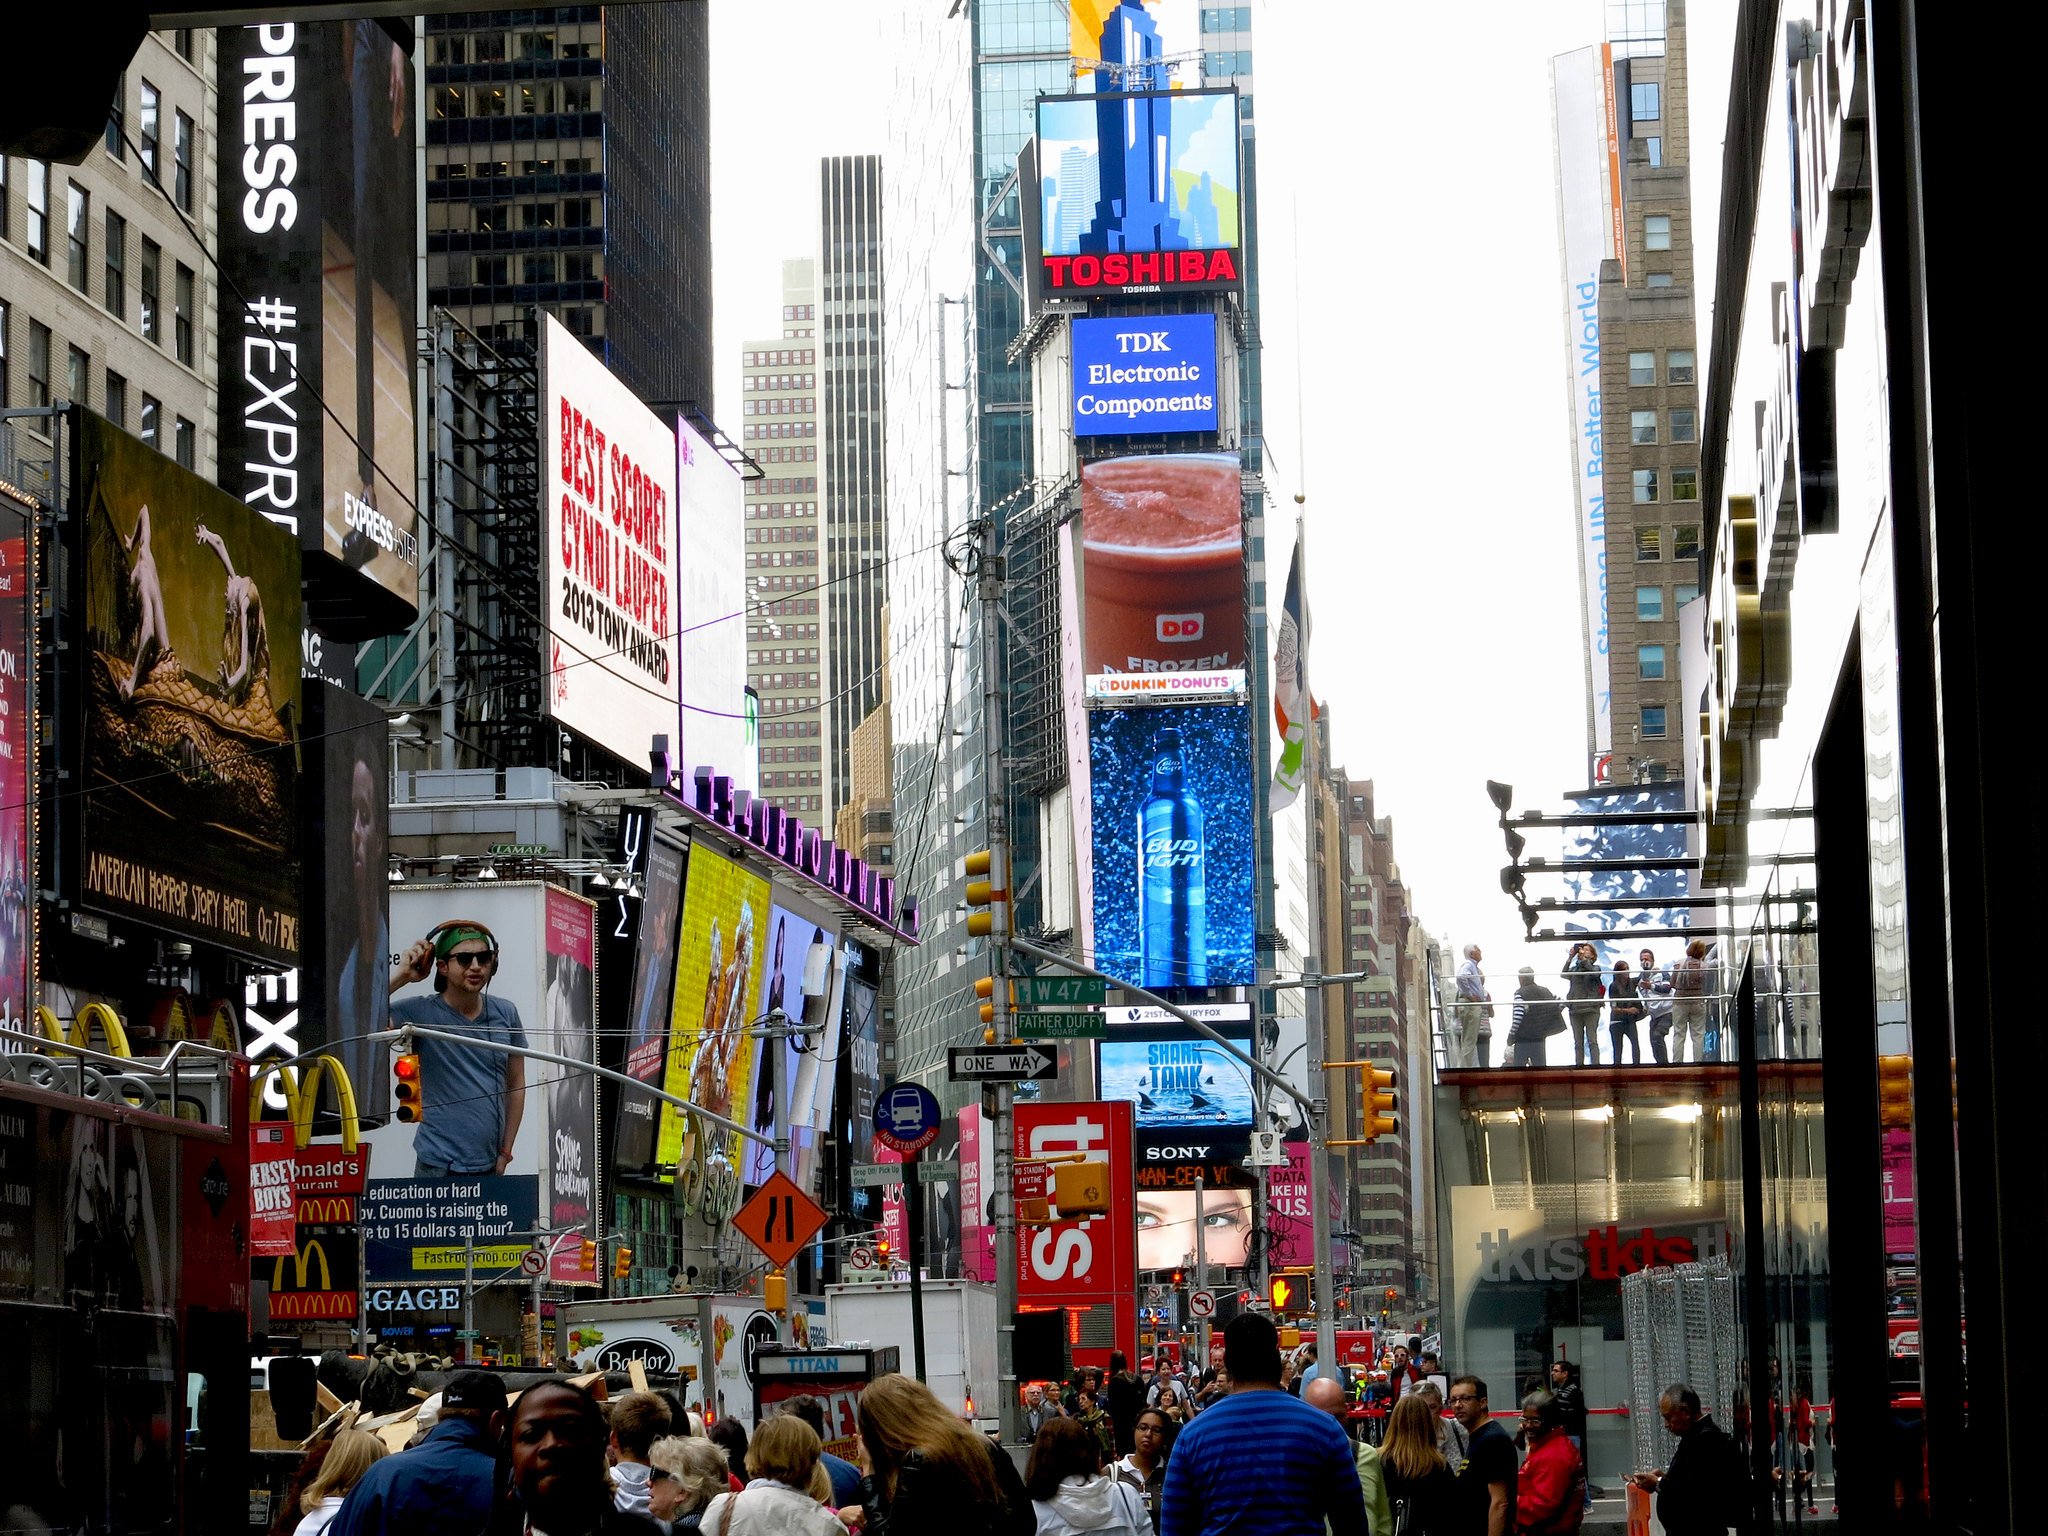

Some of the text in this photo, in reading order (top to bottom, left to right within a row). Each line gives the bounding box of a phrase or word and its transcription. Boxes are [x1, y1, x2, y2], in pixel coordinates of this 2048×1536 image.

[1044, 250, 1237, 287] TOSHIBA
[1122, 285, 1161, 294] TOSHIBA
[1044, 304, 1086, 312] SHERWOOD
[1577, 272, 1599, 376] World.
[1116, 332, 1171, 353] TDK
[1088, 361, 1200, 385] Electronic
[1077, 393, 1213, 418] Components
[561, 395, 667, 567] BEST SCORE!
[345, 491, 393, 552] EXPRESS
[561, 493, 669, 643] CYNDI LAUPER
[562, 576, 595, 634] 2013
[596, 600, 629, 658] TONY
[629, 624, 669, 686] AWARD
[1162, 619, 1200, 636] DD
[1127, 652, 1229, 673] FROZEN
[1171, 677, 1228, 689] DONUTS
[495, 845, 543, 855] LAMAR
[1146, 839, 1198, 854] BUD
[772, 808, 894, 921] BROADWAY
[88, 851, 145, 905] AMERICAN
[149, 870, 188, 920] HORROR
[191, 885, 220, 928] STORY
[223, 895, 250, 938] HOTEL
[280, 914, 296, 951] FX
[1036, 980, 1103, 1001] W 47 ST
[1018, 1013, 1105, 1029] FATHER DUFFY
[1204, 1008, 1222, 1016] FOX
[1047, 1027, 1078, 1036] SQUARE
[964, 1055, 1041, 1071] ONE WAY
[1148, 1043, 1203, 1066] SHARK
[1148, 1065, 1203, 1090] TANK
[880, 1131, 935, 1151] NO STANDING
[1146, 1146, 1210, 1160] SONY
[853, 1168, 867, 1178] Drop
[879, 1165, 890, 1174] Pick
[891, 1165, 900, 1175] Up
[1014, 1165, 1045, 1176] NO STANDING
[1273, 1171, 1306, 1183] DATA
[854, 1177, 866, 1185] Only
[1019, 1176, 1042, 1185] ANYTIME
[254, 1184, 292, 1212] BOYS
[370, 1183, 481, 1201] education or hard
[1294, 1184, 1307, 1196] IN
[380, 1204, 423, 1219] Cuomo
[426, 1203, 437, 1218] is
[440, 1202, 484, 1220] raising
[486, 1202, 508, 1217] the
[1277, 1198, 1311, 1217] U.S.
[377, 1221, 514, 1239] to 15 dollars an hour?
[1476, 1228, 1585, 1282] tkts
[1584, 1225, 1693, 1281] tkts
[1020, 1260, 1028, 1281] Fund
[382, 1327, 414, 1337] BOWER
[506, 1355, 515, 1364] A
[1557, 1342, 1567, 1361] 1
[787, 1358, 838, 1372] TITAN
